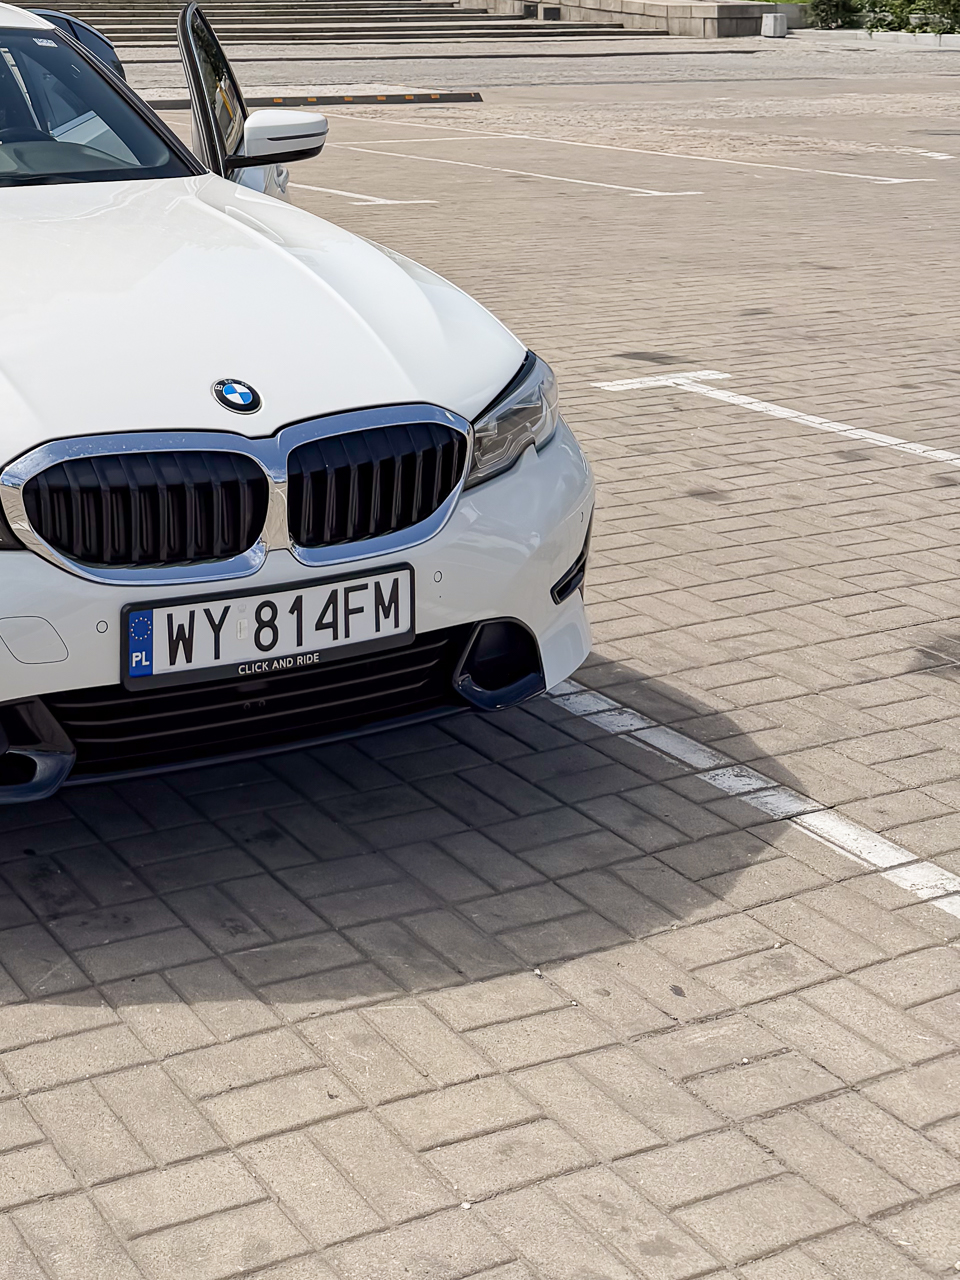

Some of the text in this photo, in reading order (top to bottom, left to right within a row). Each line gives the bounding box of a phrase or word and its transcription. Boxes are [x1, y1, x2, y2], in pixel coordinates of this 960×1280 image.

[166, 577, 400, 667] WY 814FM
[131, 651, 151, 668] PL
[238, 652, 320, 675] CLICK AND RIDE
